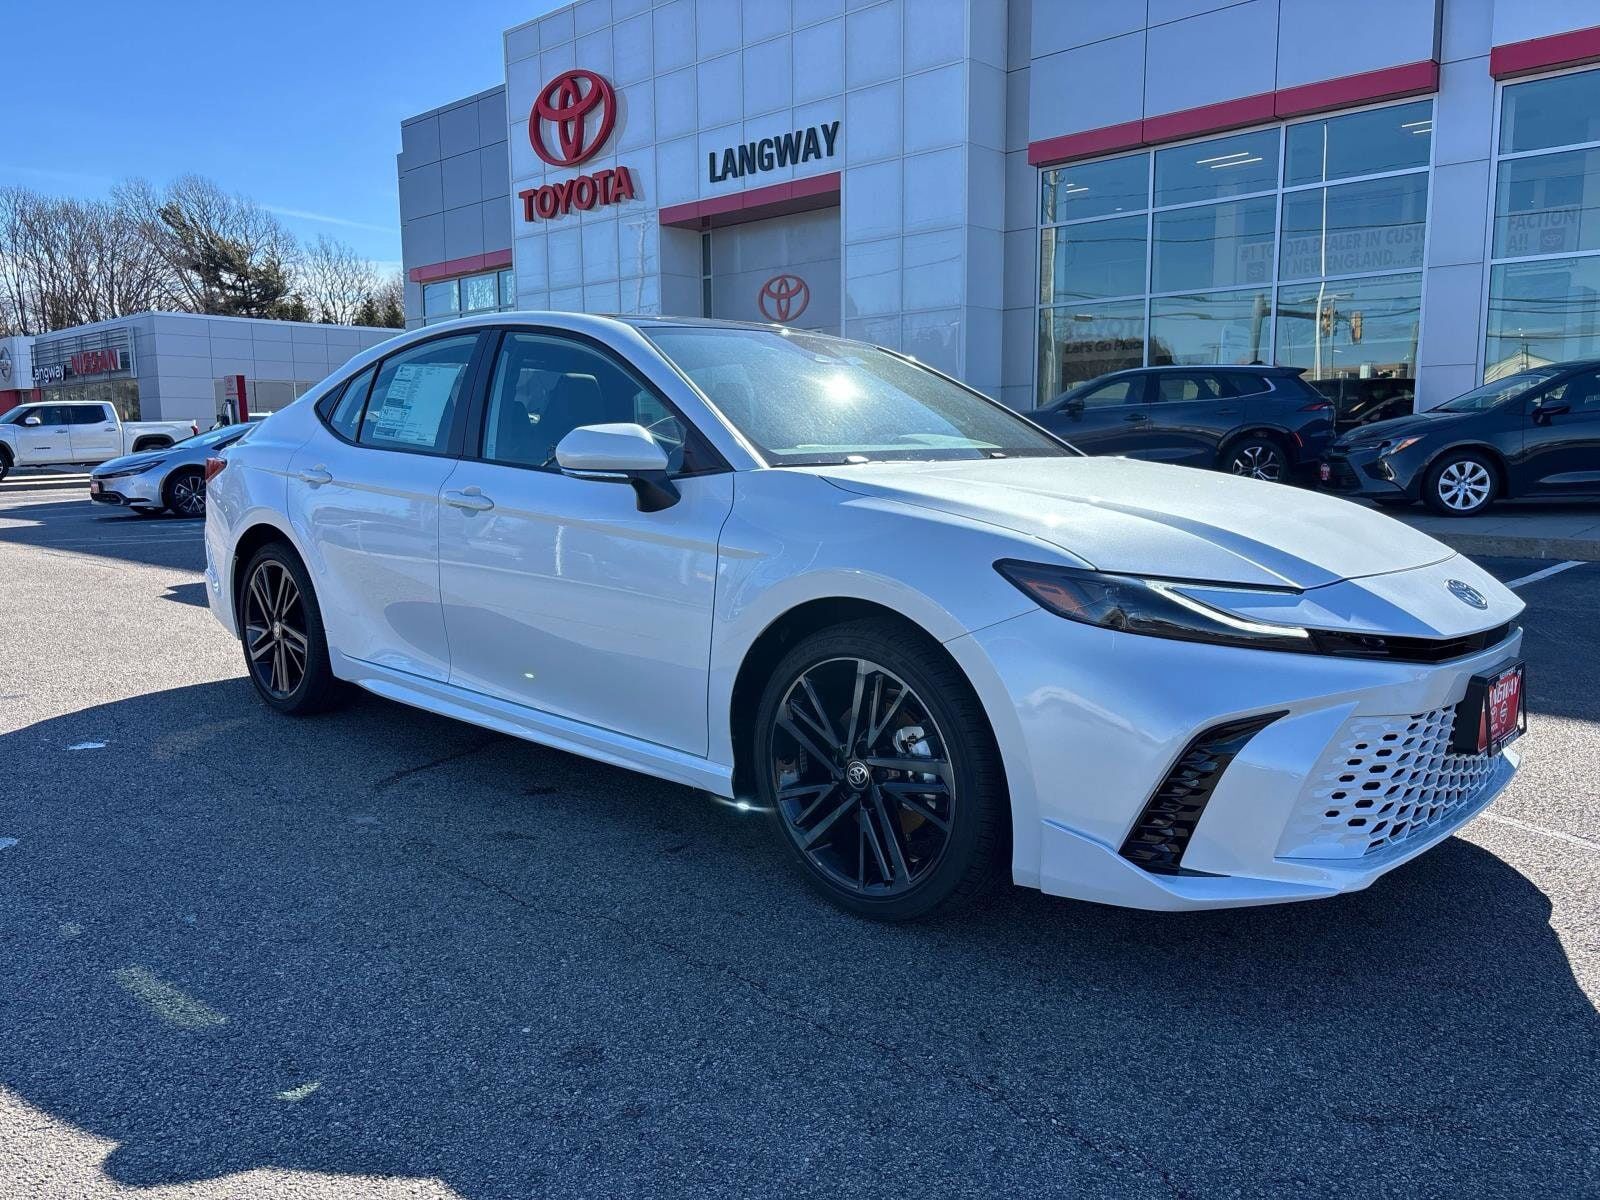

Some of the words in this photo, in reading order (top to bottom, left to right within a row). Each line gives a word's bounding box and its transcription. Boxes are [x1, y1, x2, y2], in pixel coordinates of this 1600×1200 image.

[709, 121, 839, 183] LANGWAY
[518, 166, 634, 222] TOYOTA
[1260, 238, 1309, 259] TOOTA
[1313, 232, 1361, 254] DALER
[1365, 230, 1382, 248] IN
[1095, 340, 1111, 352] Go
[71, 348, 121, 375] NISSAN
